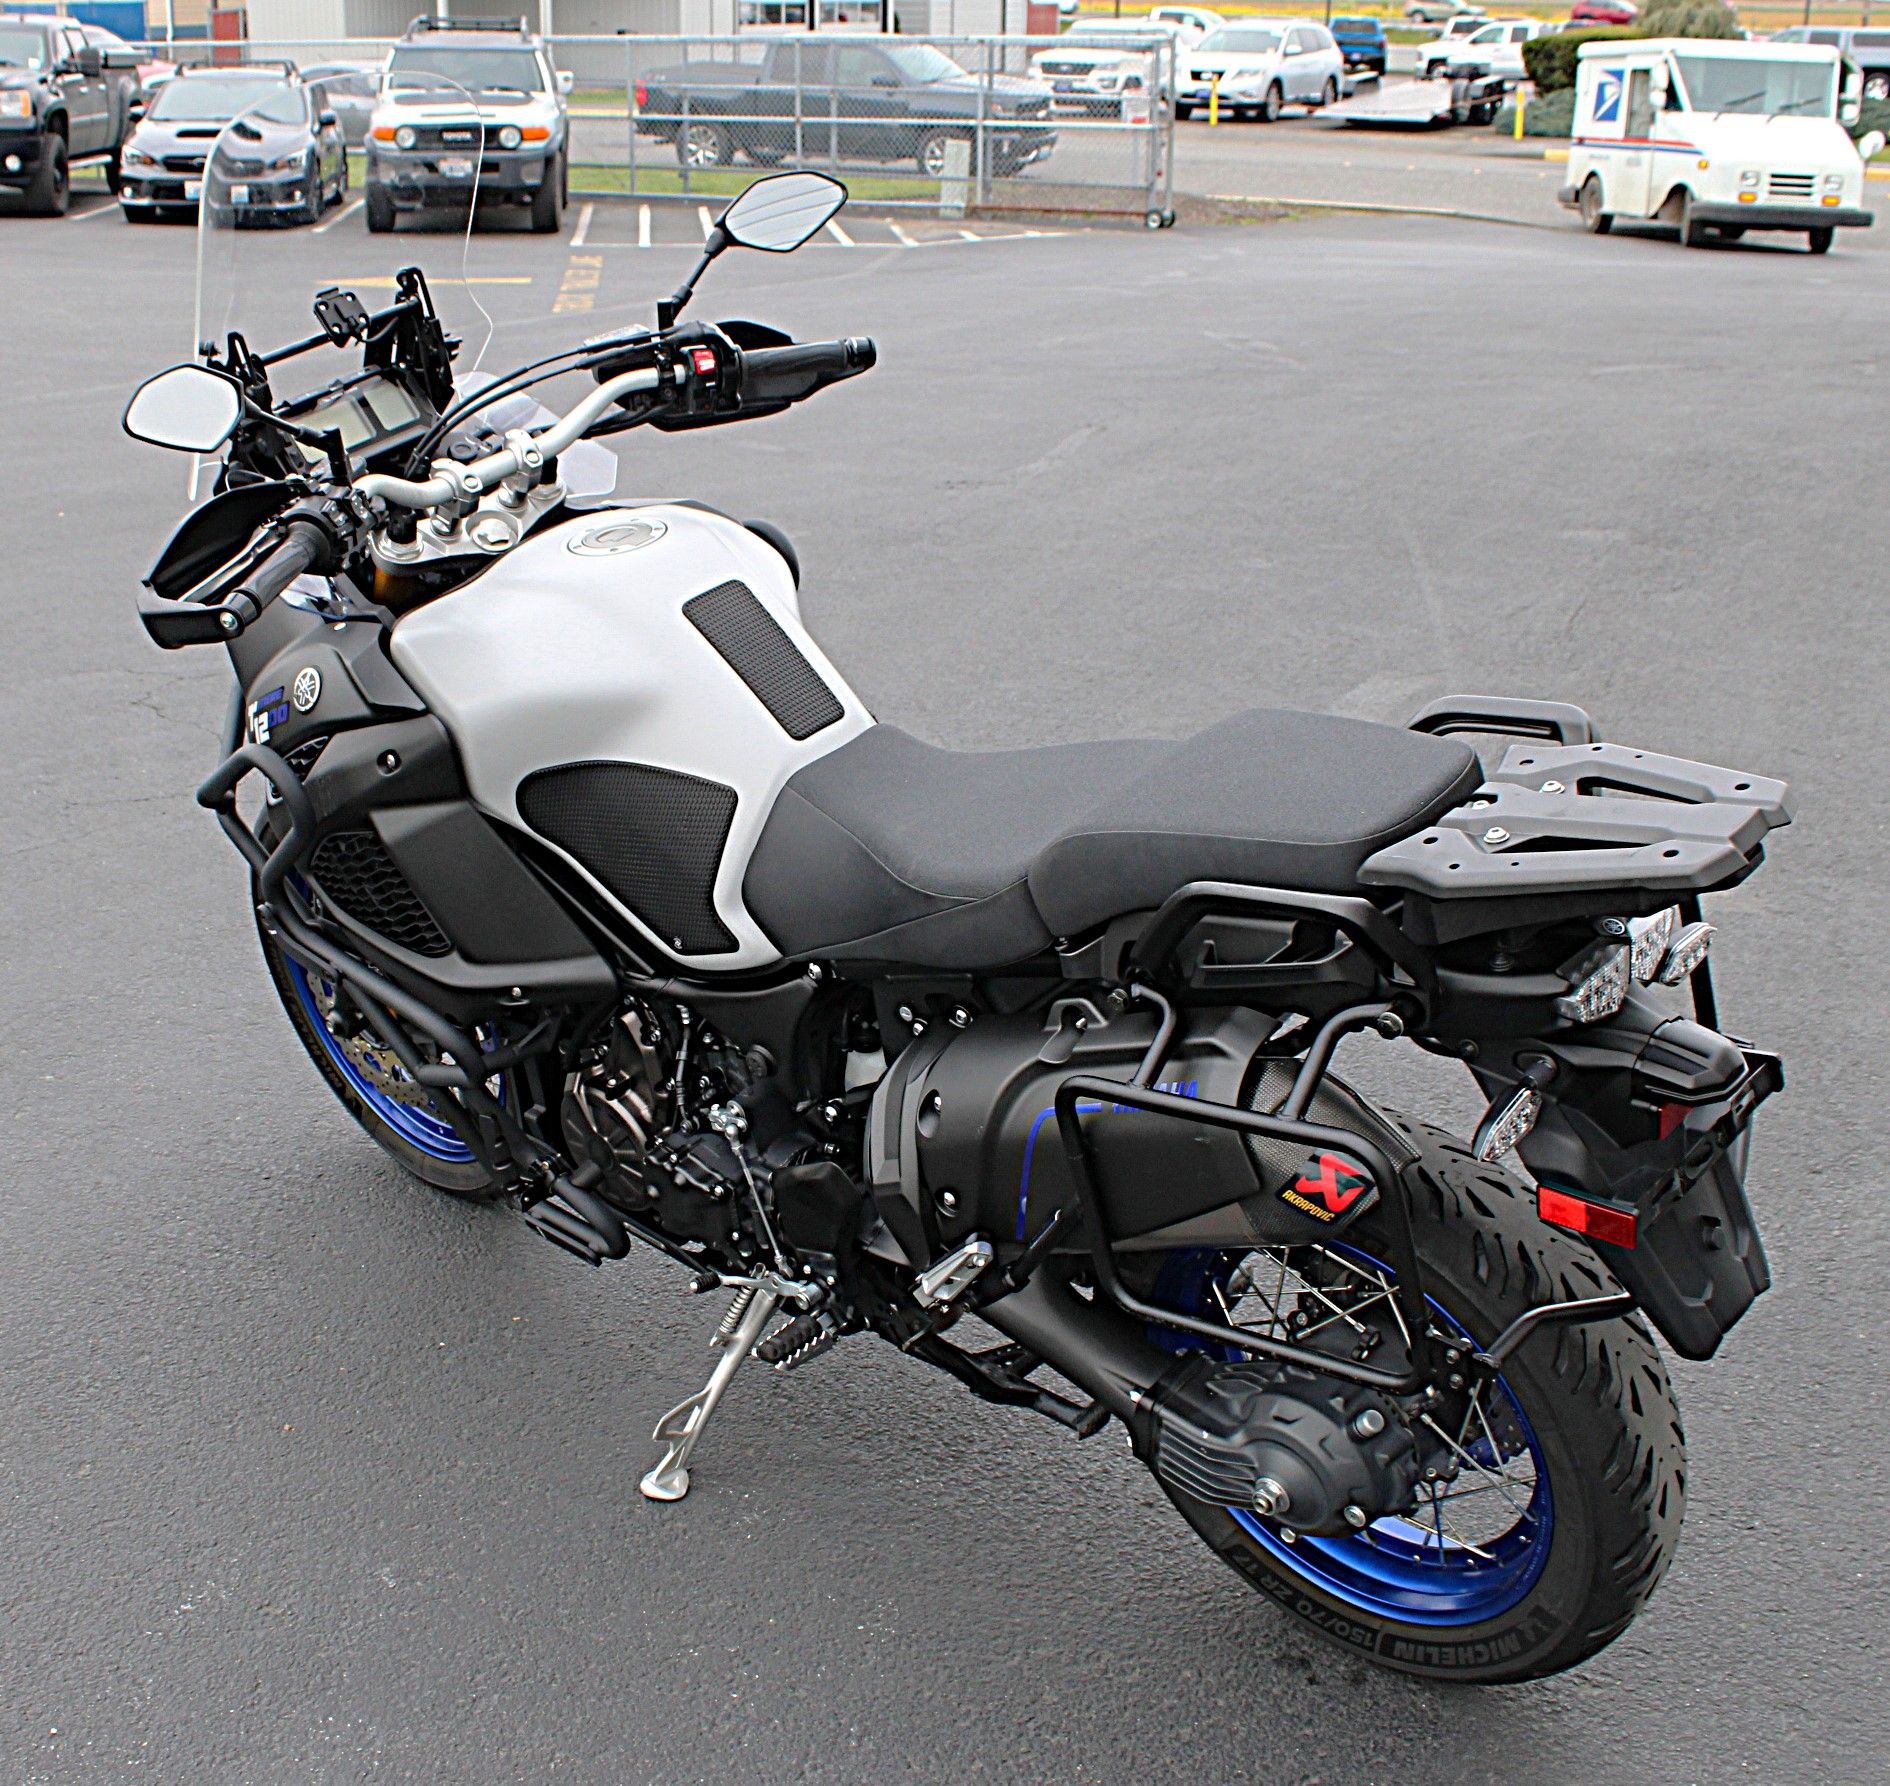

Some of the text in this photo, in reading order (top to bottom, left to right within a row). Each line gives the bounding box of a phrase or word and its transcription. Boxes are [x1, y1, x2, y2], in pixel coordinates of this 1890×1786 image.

[1233, 1552, 1375, 1648] 150/70 ZR 17
[1393, 1632, 1522, 1665] MICHELIN
